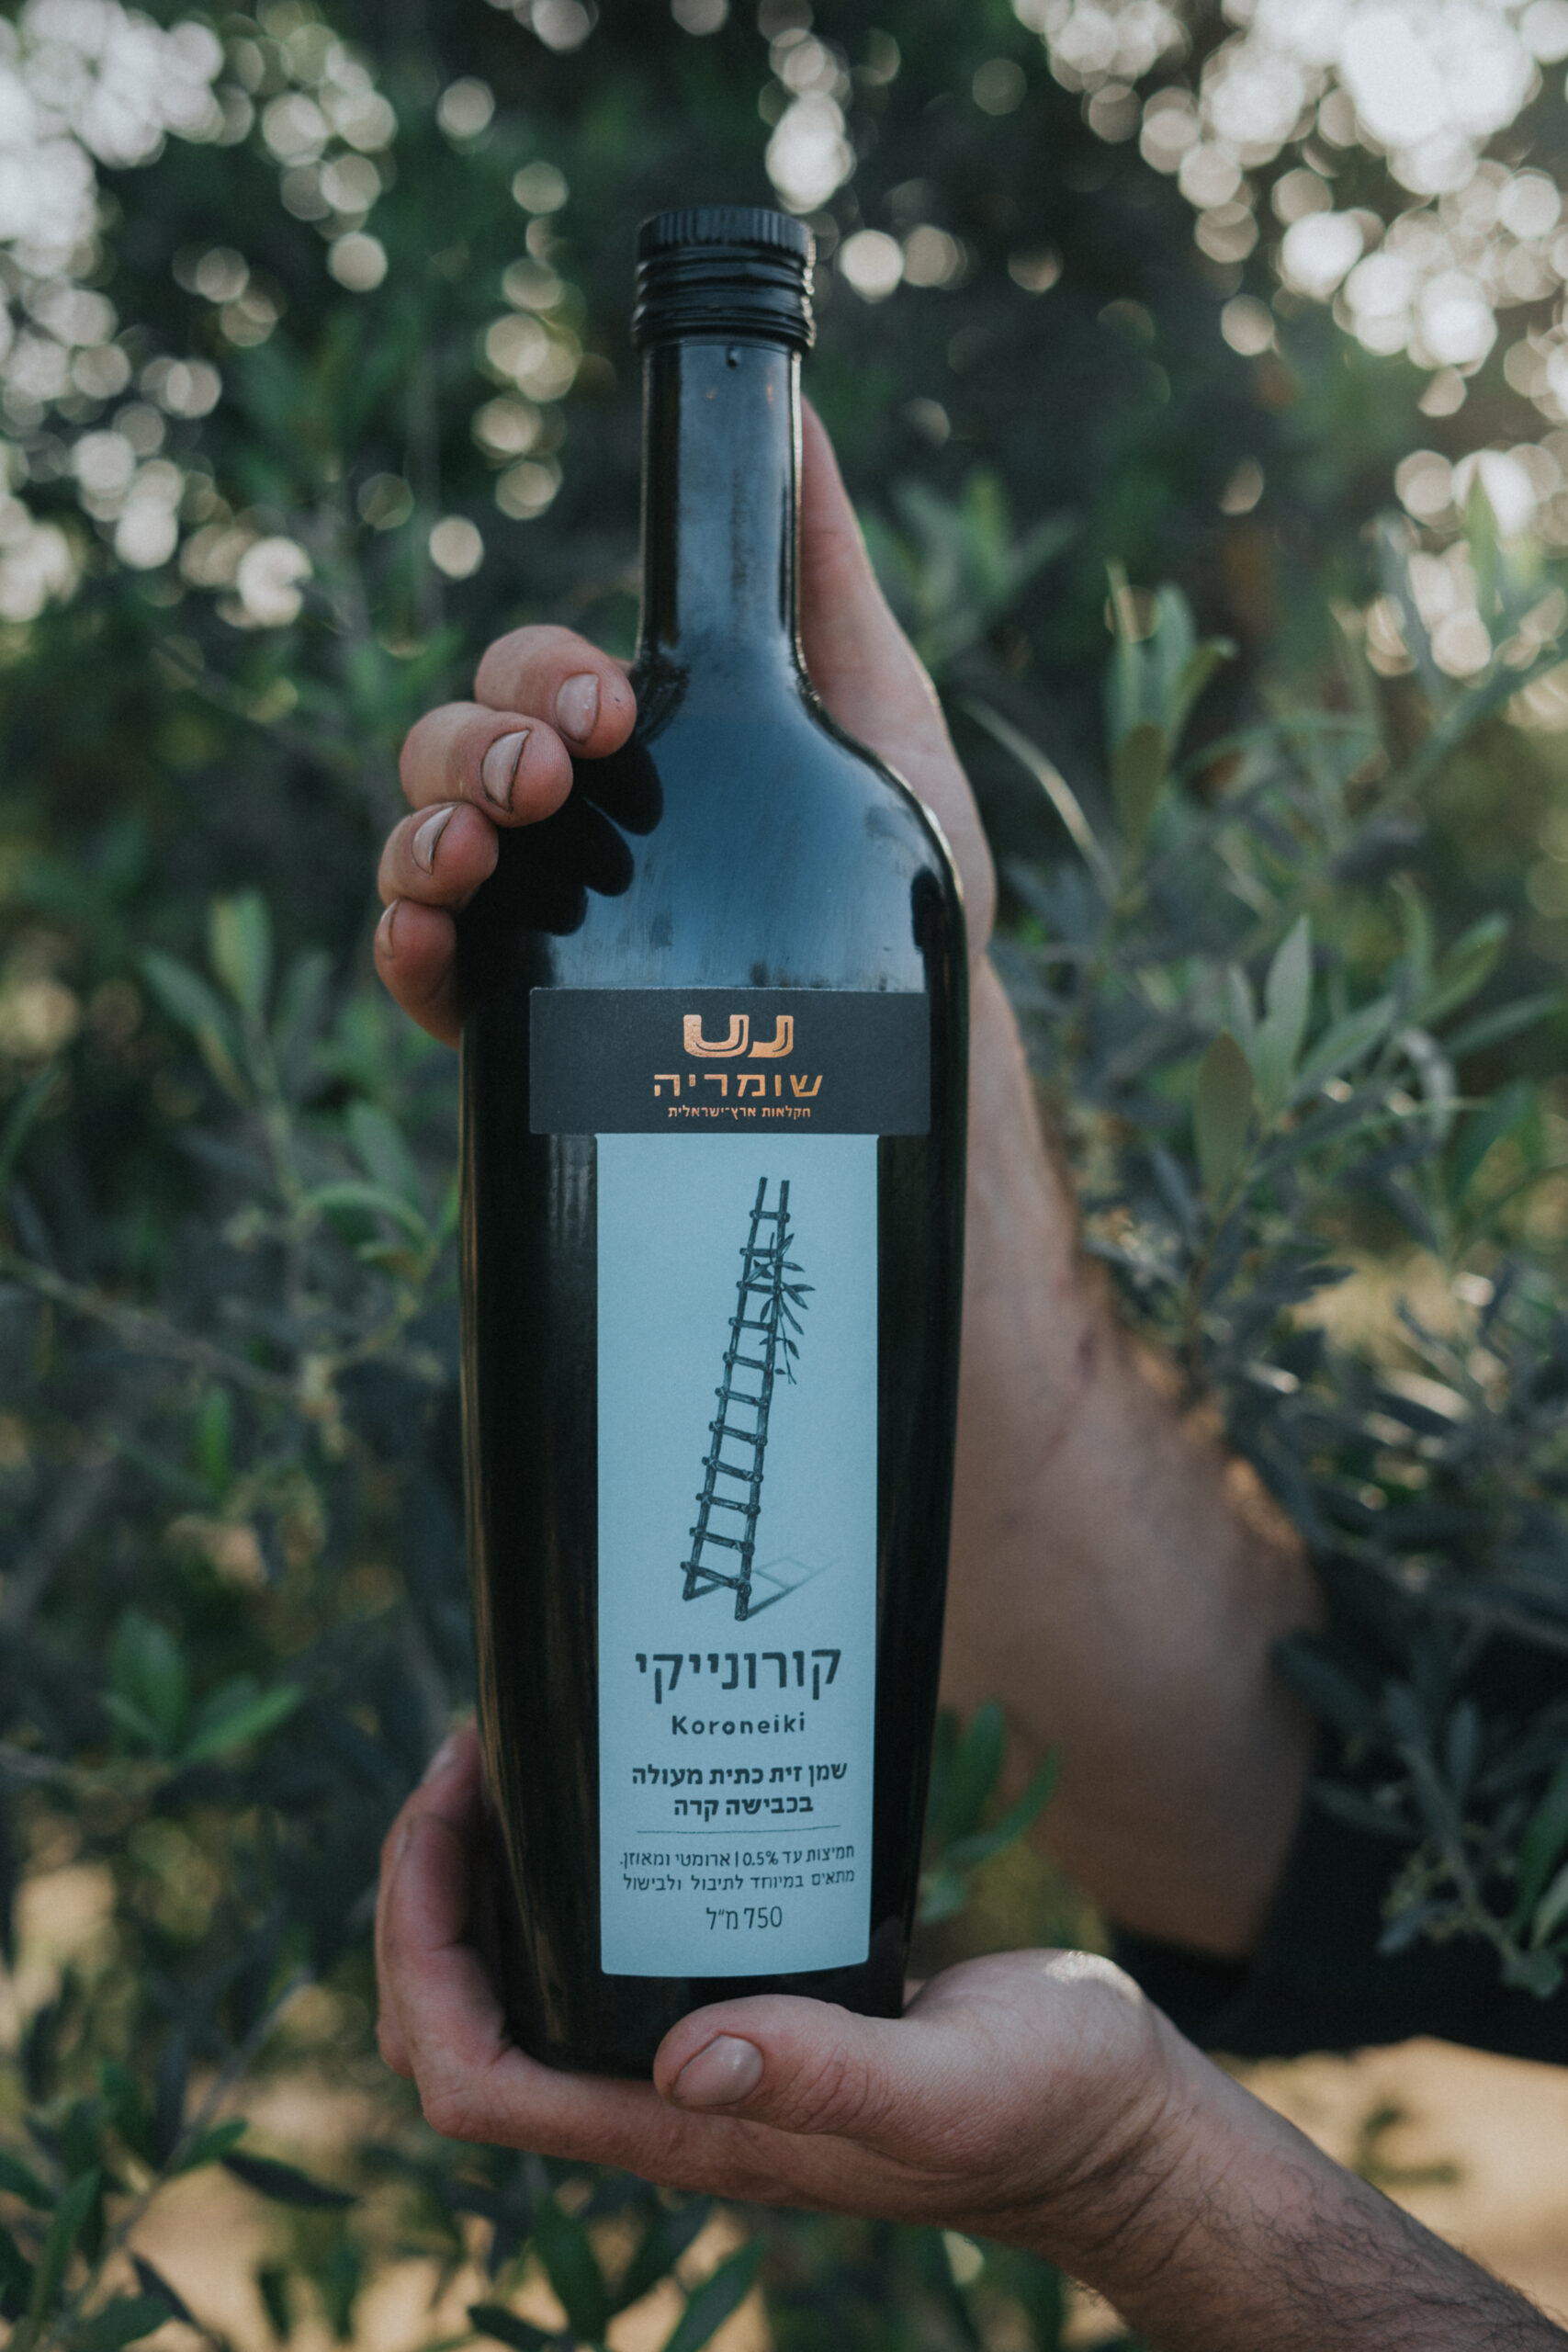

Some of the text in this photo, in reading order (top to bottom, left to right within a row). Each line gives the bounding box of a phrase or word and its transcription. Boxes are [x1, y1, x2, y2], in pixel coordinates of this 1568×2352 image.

[654, 1074, 823, 1098] שומריה
[761, 1105, 811, 1121] חקלאות
[635, 1648, 841, 1705] קורונייקי
[671, 1711, 806, 1736] Koroneiki
[632, 1762, 848, 1788] שמן זית כתית מעולה
[674, 1795, 814, 1823] בכבישה קרה
[674, 1852, 732, 1867] ארומטי
[741, 1849, 780, 1868] 0.5%
[781, 1849, 803, 1864] עד
[806, 1844, 855, 1864] חמיצות
[623, 1869, 855, 1892] מתאים במיוחד לתיבול ולבישול
[743, 1905, 783, 1929] 750
